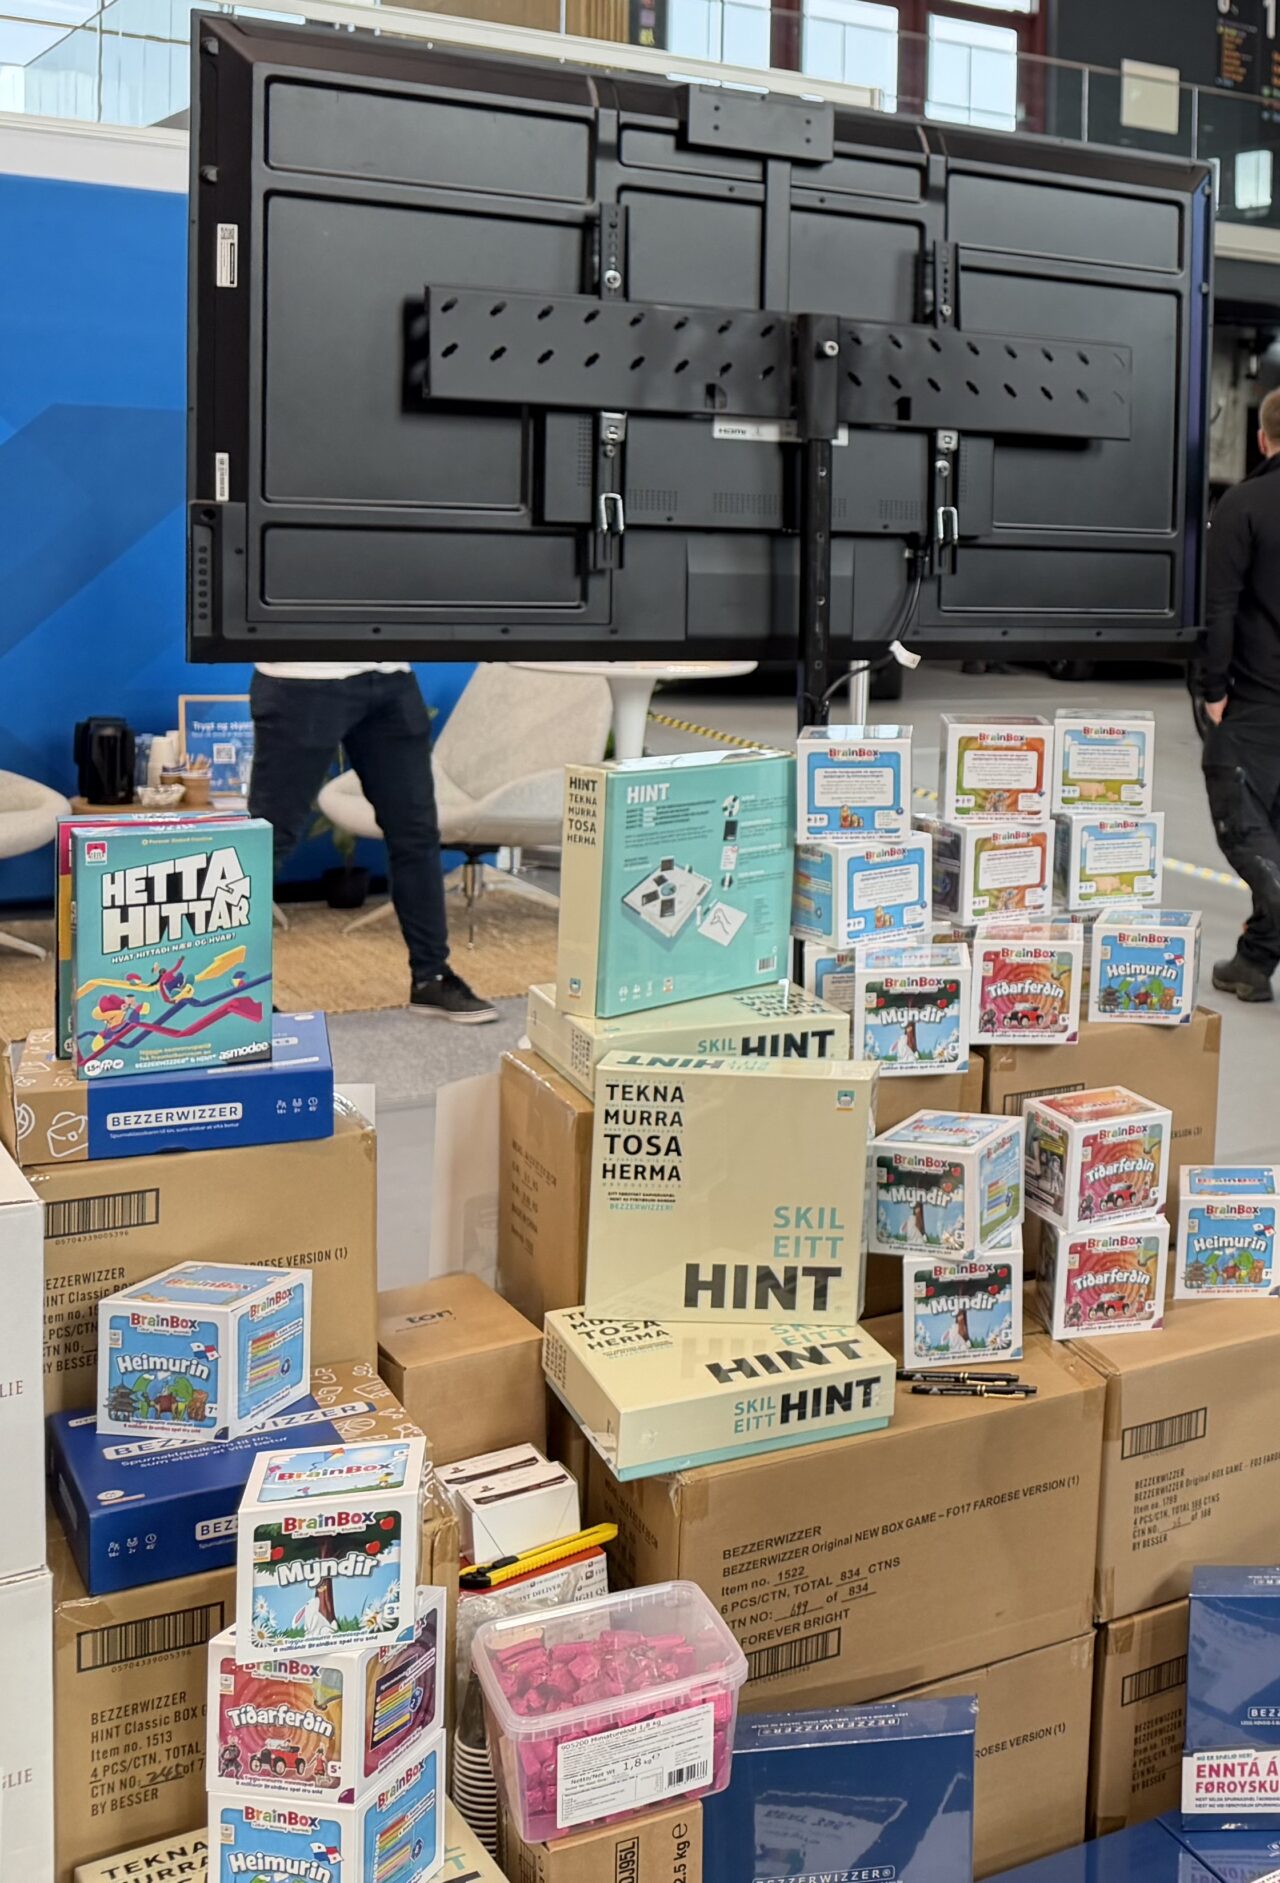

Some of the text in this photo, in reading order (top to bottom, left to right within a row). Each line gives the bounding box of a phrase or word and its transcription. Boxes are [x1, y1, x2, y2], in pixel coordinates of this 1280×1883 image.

[569, 776, 598, 793] HINT
[627, 783, 670, 803] HINT
[569, 793, 598, 806] TEKNA
[568, 806, 597, 818] MURRA
[568, 819, 597, 834] TOSA
[567, 833, 596, 845] HERMA
[102, 846, 246, 907] HETTA
[102, 888, 250, 955] HITTAR
[1118, 933, 1169, 943] BrainBox
[112, 937, 208, 964] HVAT OG
[1001, 948, 1056, 958] BrainBox
[885, 977, 944, 988] BrainBox
[1106, 963, 1178, 981] Heimurin
[986, 978, 1064, 999] Tíðarferðin
[880, 1005, 946, 1027] Myndir
[219, 1041, 269, 1060] asmodee
[698, 1029, 836, 1057] SKIL HINT
[605, 1084, 685, 1103] TEKNA
[112, 1106, 238, 1127] BEZZERWIZZER
[604, 1109, 683, 1127] MURRA
[1099, 1125, 1148, 1140] BrainBox
[603, 1134, 682, 1157] TOSA
[602, 1163, 681, 1181] HERMA
[894, 1154, 947, 1168] BrainBox
[1086, 1158, 1154, 1182] Tíðarferðin
[891, 1187, 950, 1208] Myndir
[773, 1206, 845, 1230] SKIL
[1206, 1205, 1259, 1214] BrainBox
[773, 1236, 844, 1258] EITT
[1087, 1236, 1142, 1248] BrainBox
[1194, 1236, 1267, 1251] Heimurin
[286, 1247, 348, 1268] VERSION (1)
[46, 1267, 125, 1290] EZZERWIZZER
[934, 1263, 993, 1276] BrainBox
[1074, 1268, 1151, 1291] Tíðarferðin
[46, 1287, 110, 1307] INT Classic
[684, 1263, 843, 1311] HINT
[250, 1287, 293, 1318] BrainBox
[930, 1293, 999, 1316] Myndir
[67, 1311, 84, 1320] no.
[130, 1313, 198, 1329] BrainBox
[577, 1319, 661, 1340] TOSA
[586, 1329, 670, 1350] HERMA
[57, 1354, 98, 1372] BESSE
[117, 1354, 210, 1379] Heimurin
[706, 1339, 868, 1384] HINT
[734, 1397, 776, 1416] SKIL
[780, 1376, 882, 1425] HINT
[734, 1415, 776, 1434] EITT
[278, 1462, 393, 1481] BrainBox
[1135, 1468, 1185, 1490] BEZZERWIZZER
[1134, 1480, 1185, 1502] BEZZERWIZZER
[283, 1512, 376, 1533] BrainBox
[722, 1475, 1080, 1579] BEZZERWIZZER Original NEW BOX GAME FO17 FAROESE VERSION (1)
[722, 1525, 822, 1561] BEZZERWIZZER
[1143, 1533, 1168, 1549] BESSER
[278, 1552, 380, 1590] Myndir
[721, 1566, 806, 1597] Item no. 1522
[721, 1603, 729, 1615] 6
[794, 1577, 833, 1594] TOTAL
[840, 1568, 861, 1583] 834
[868, 1557, 901, 1574] CTNS
[749, 1582, 870, 1627] NO: of 834
[741, 1608, 851, 1647] FOREVER BRIGHT
[243, 1660, 320, 1678] BrainBox
[91, 1691, 187, 1726] BEZZERWIZZER
[91, 1706, 198, 1744] HINT Classic BOX
[227, 1705, 335, 1737] Tíðarferðin
[91, 1730, 174, 1762] Item no. 1513
[1007, 1722, 1066, 1752] VERSION (1)
[165, 1741, 200, 1763] TOTAL
[623, 1757, 642, 1772] 1,8
[1196, 1756, 1279, 1779] ENNTÁ Á
[91, 1761, 196, 1799] CTN NO: of
[378, 1759, 426, 1806] BrainBox
[91, 1788, 159, 1817] BY BESSER
[244, 1806, 320, 1828] BrainBox
[101, 1840, 208, 1880] TEKNA
[673, 1841, 691, 1861] kg
[228, 1852, 332, 1883] Heimurin
